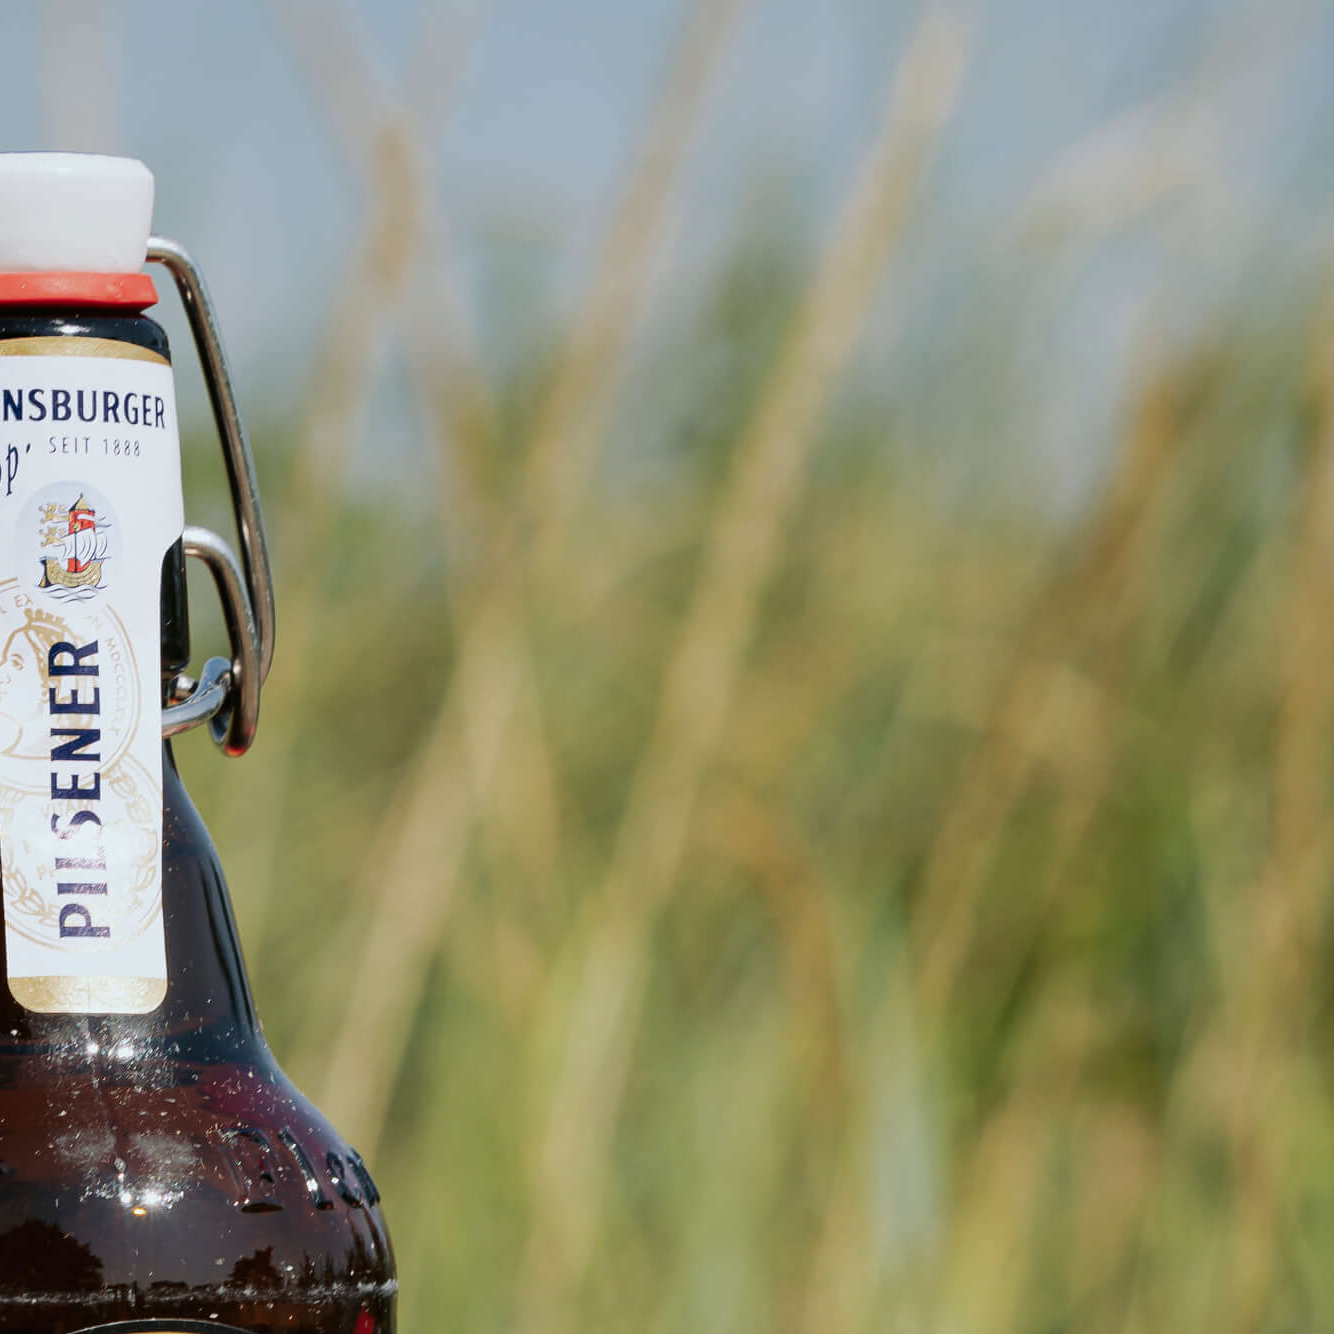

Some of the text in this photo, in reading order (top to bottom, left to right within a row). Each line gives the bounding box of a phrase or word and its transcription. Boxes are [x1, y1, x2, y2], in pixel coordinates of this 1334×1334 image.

[48, 436, 141, 456] SEIT 1888
[48, 639, 111, 939] PILSENER
